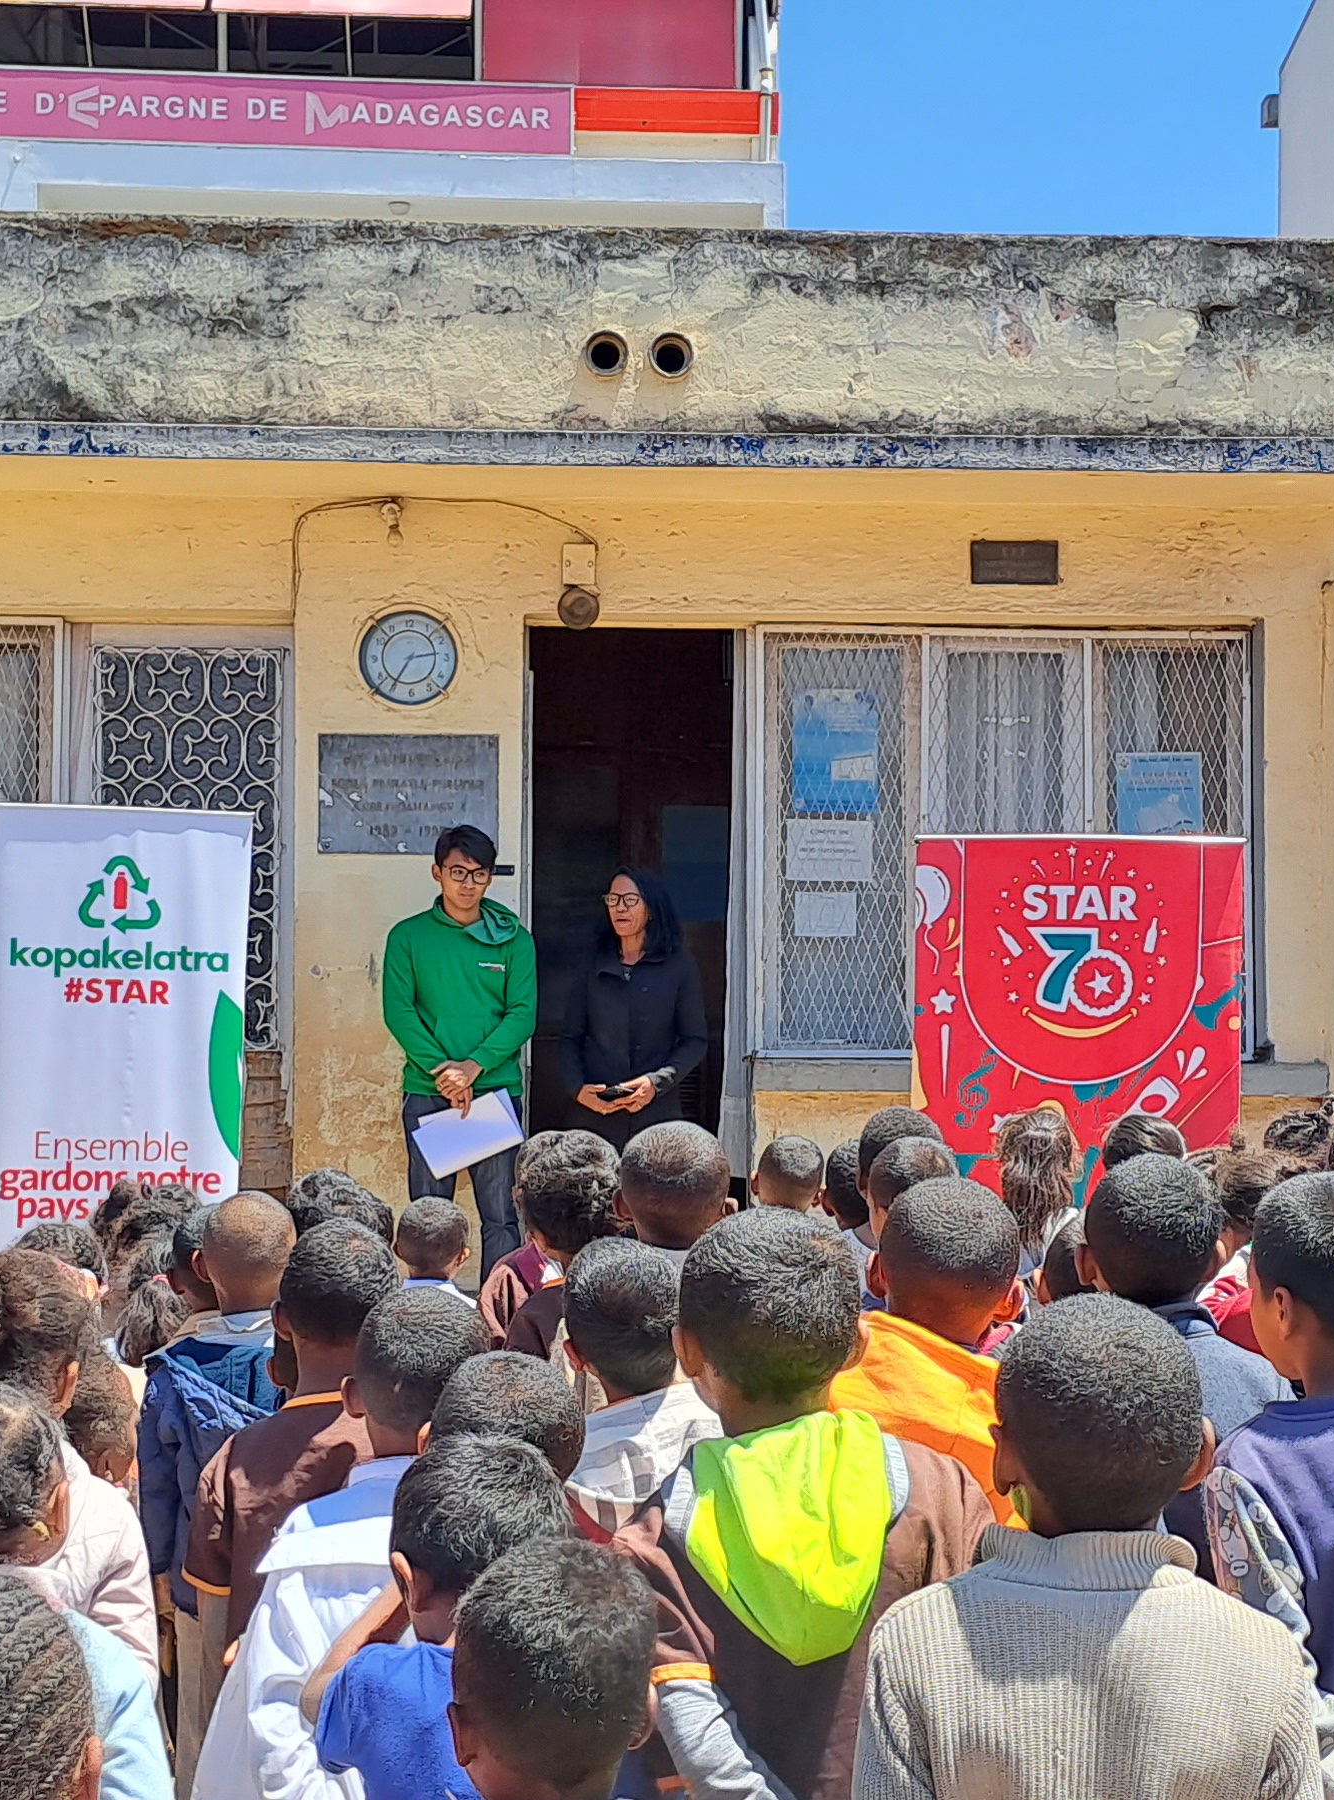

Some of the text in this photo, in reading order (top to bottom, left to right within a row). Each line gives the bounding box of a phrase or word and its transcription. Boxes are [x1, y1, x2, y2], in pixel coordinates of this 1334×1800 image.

[246, 98, 288, 121] DE
[305, 91, 551, 136] MADAGASCAR
[1022, 884, 1139, 922] STAR
[9, 935, 229, 977] kopakelatra
[63, 977, 170, 1005] #STAR
[34, 1131, 189, 1163] Ensemble
[17, 1197, 90, 1228] pays
